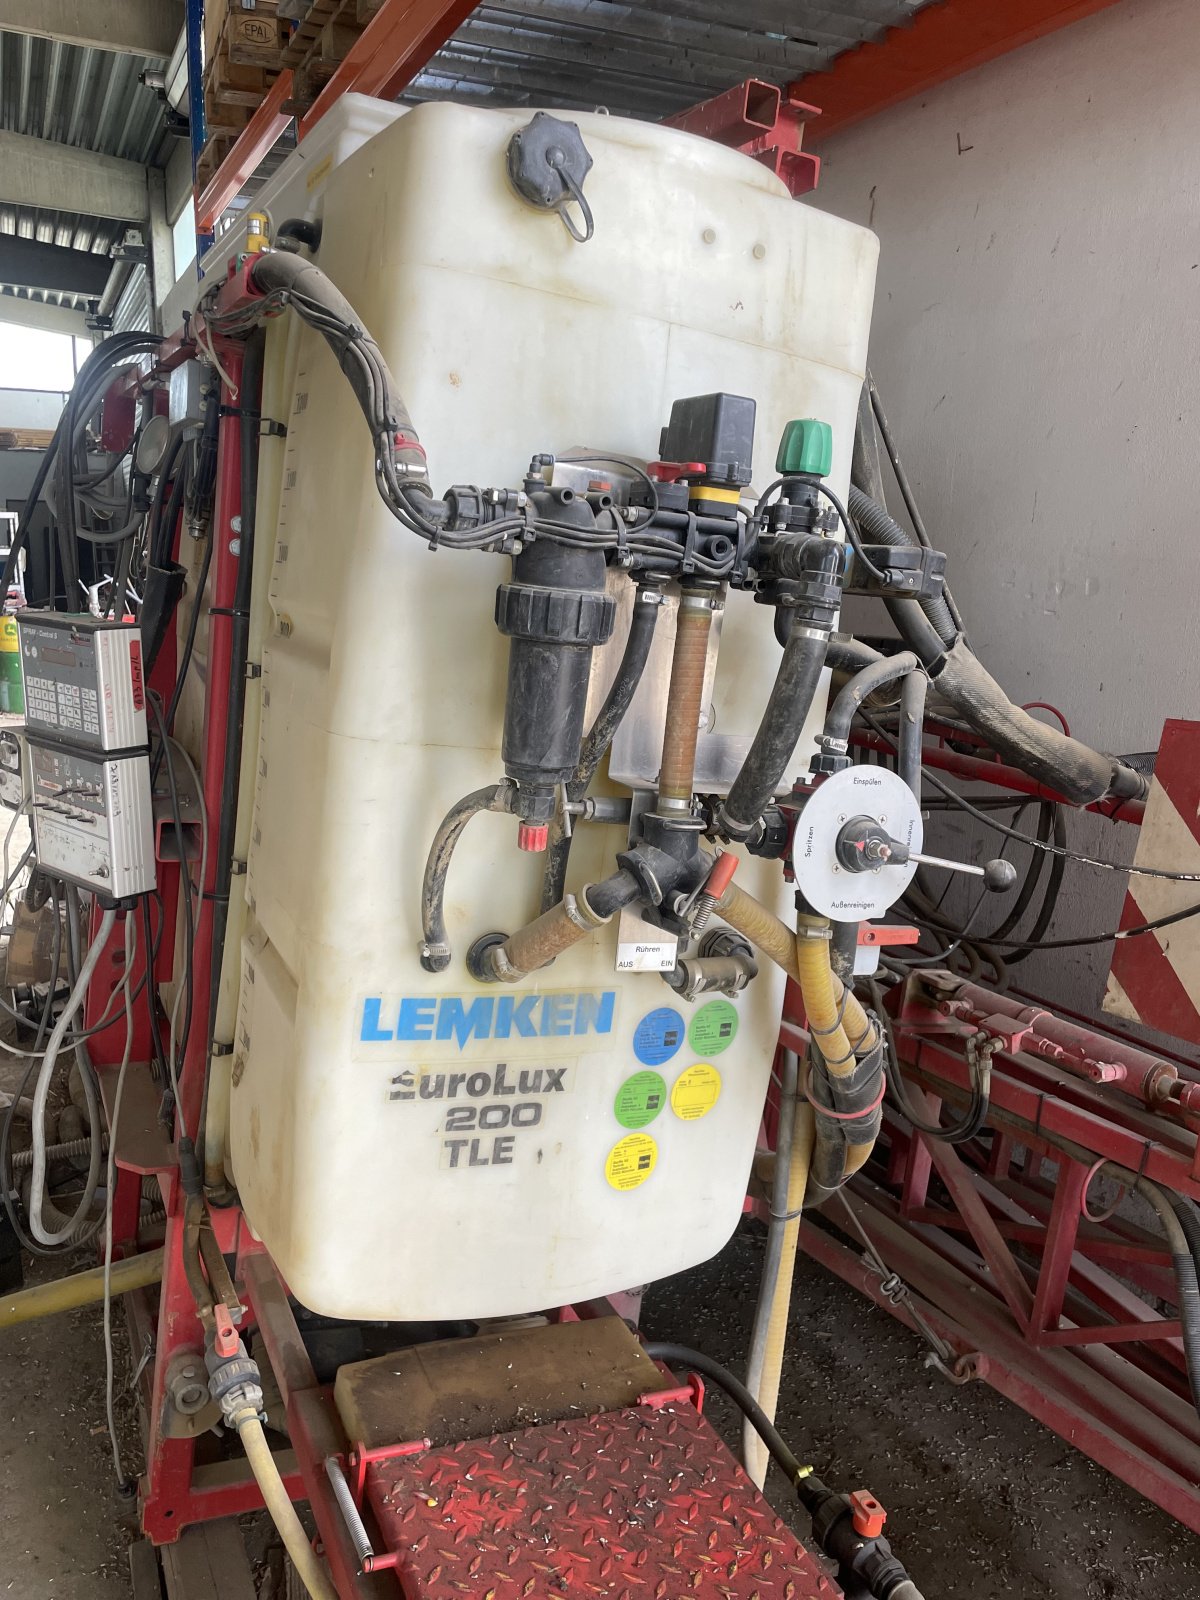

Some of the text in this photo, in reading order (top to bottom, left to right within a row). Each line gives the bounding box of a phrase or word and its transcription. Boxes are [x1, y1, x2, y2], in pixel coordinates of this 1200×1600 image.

[853, 777, 882, 787] Einspülen
[804, 826, 814, 857] Spritzen
[831, 900, 875, 910] Außenreinigen
[635, 945, 661, 953] Rühren
[617, 960, 634, 968] AUS
[360, 991, 616, 1051] LEMKEN
[445, 1102, 543, 1131] 200
[444, 1136, 516, 1168] TLE
